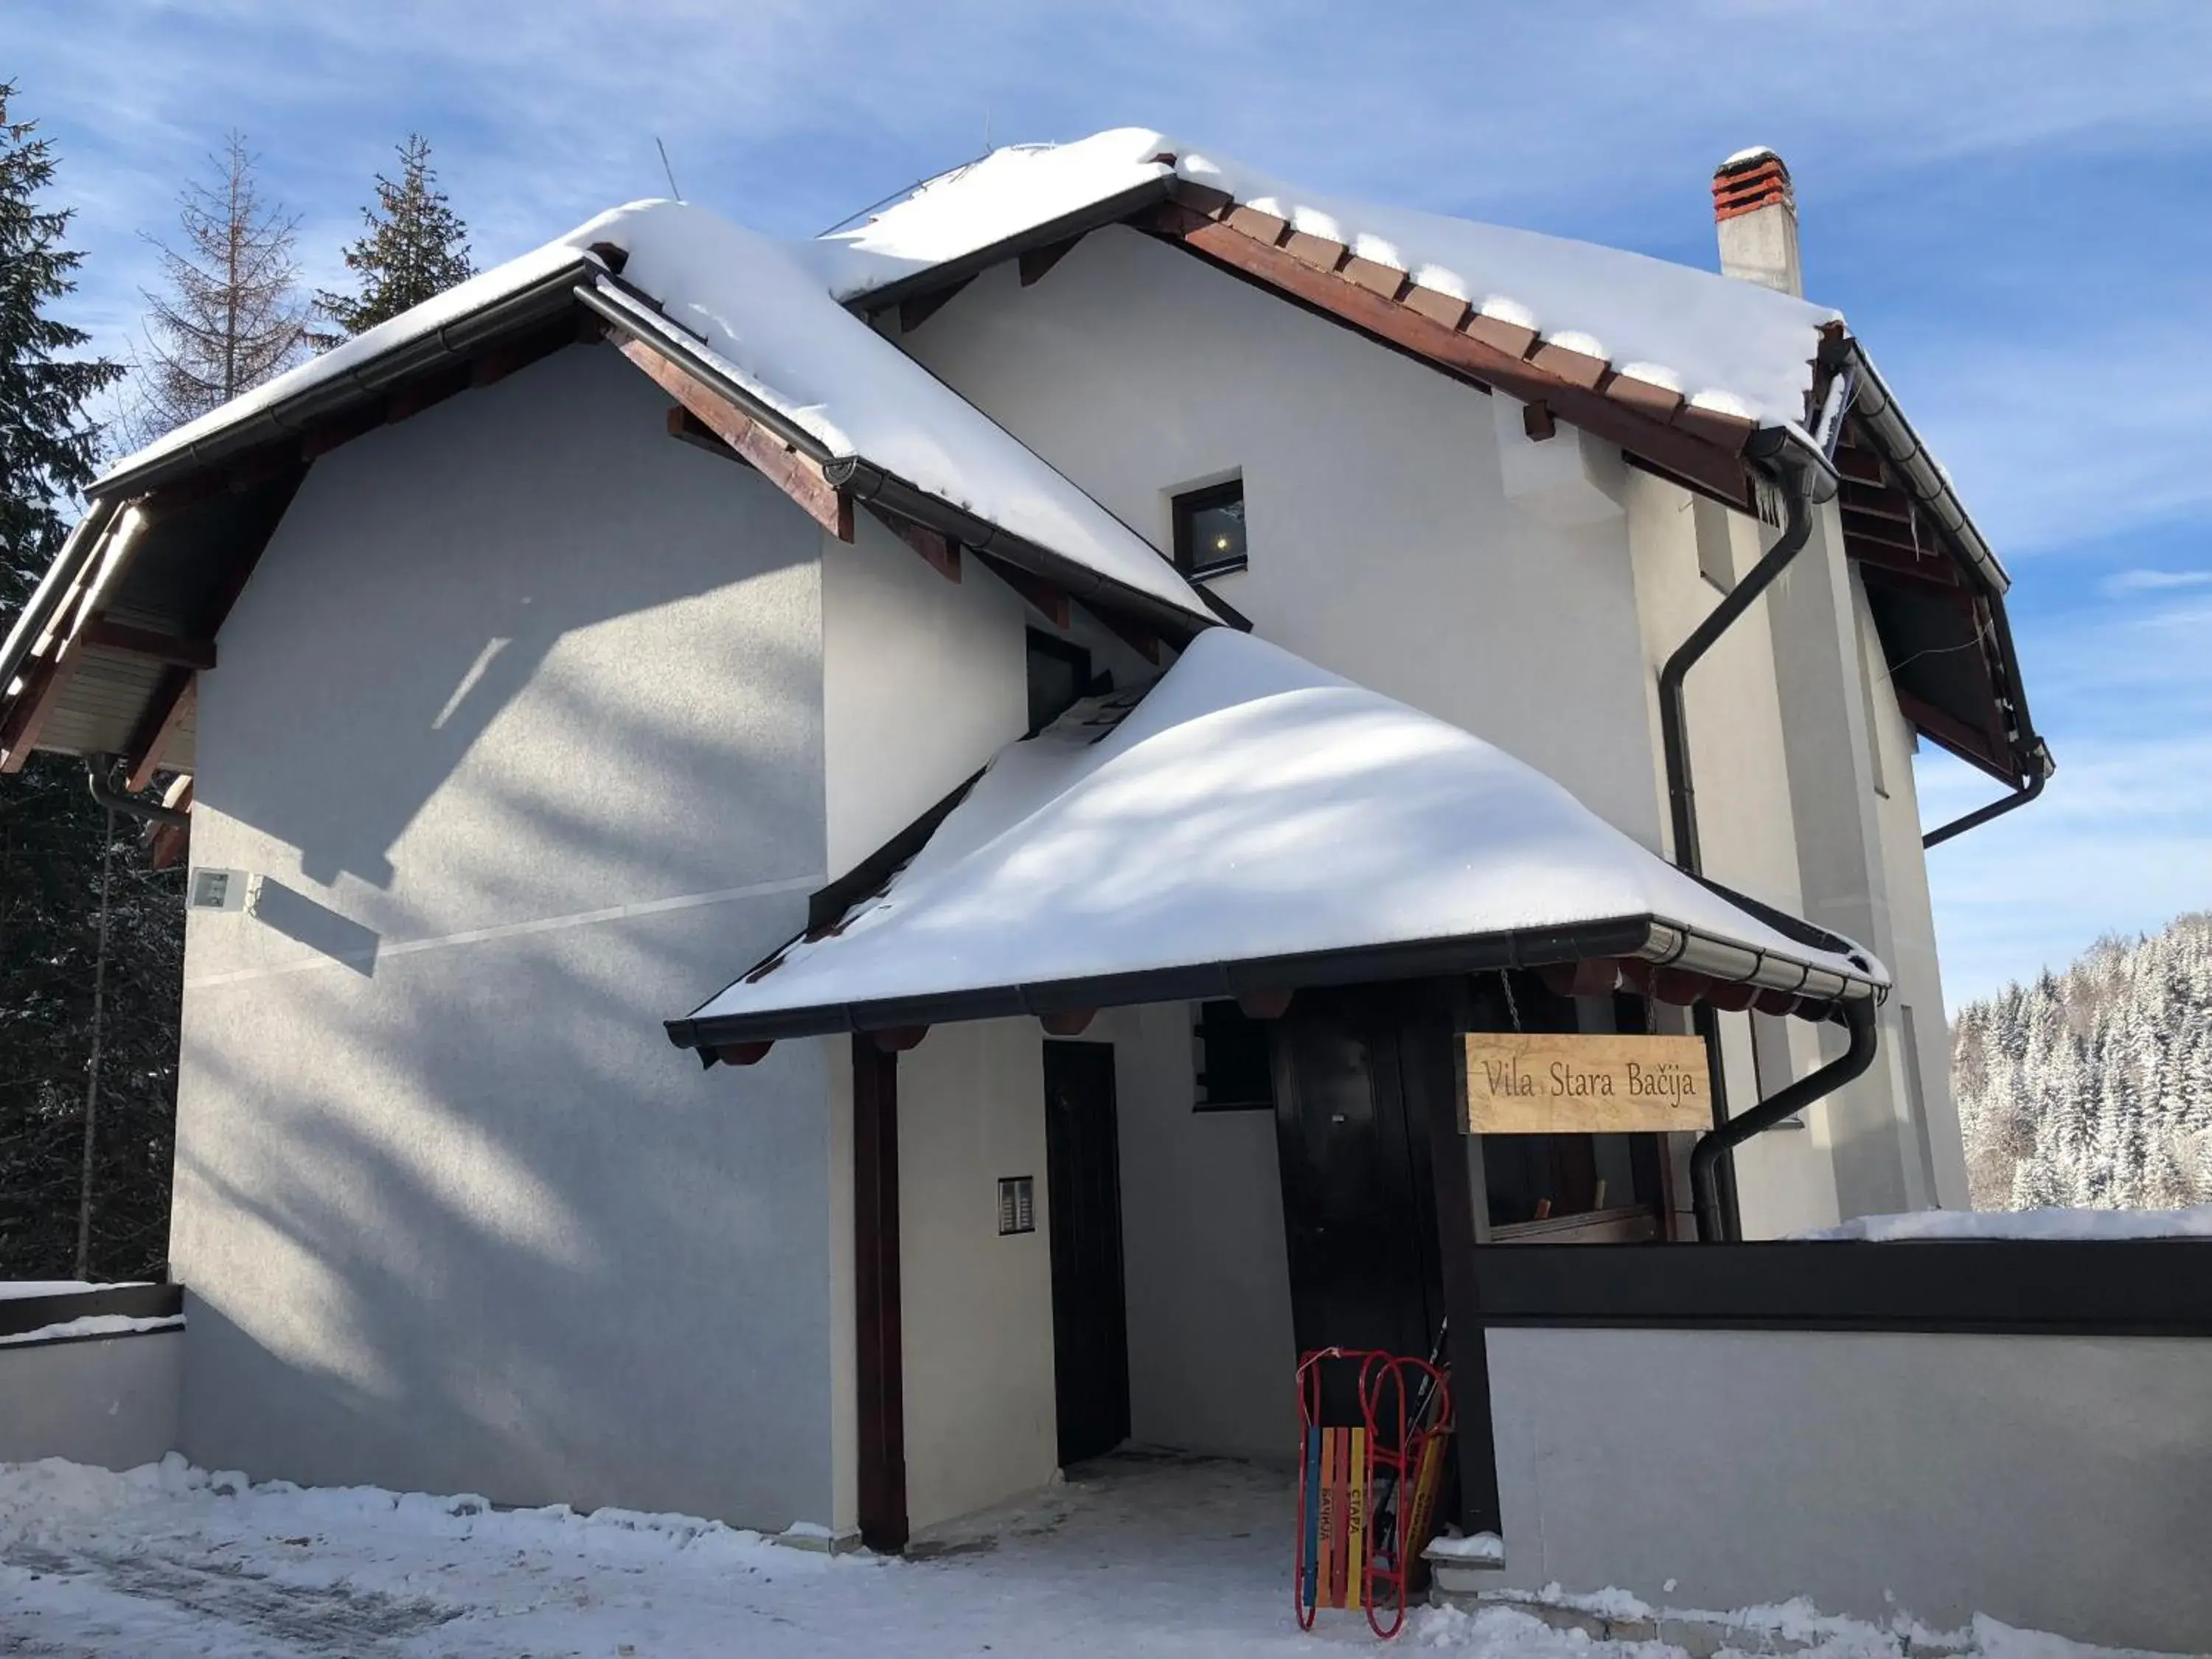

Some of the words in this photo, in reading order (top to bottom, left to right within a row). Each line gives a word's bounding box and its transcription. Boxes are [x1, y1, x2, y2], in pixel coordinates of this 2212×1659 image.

[1482, 1057, 1535, 1097] Vila
[1549, 1061, 1615, 1097] Stara
[1626, 1062, 1697, 1108] Bačija
